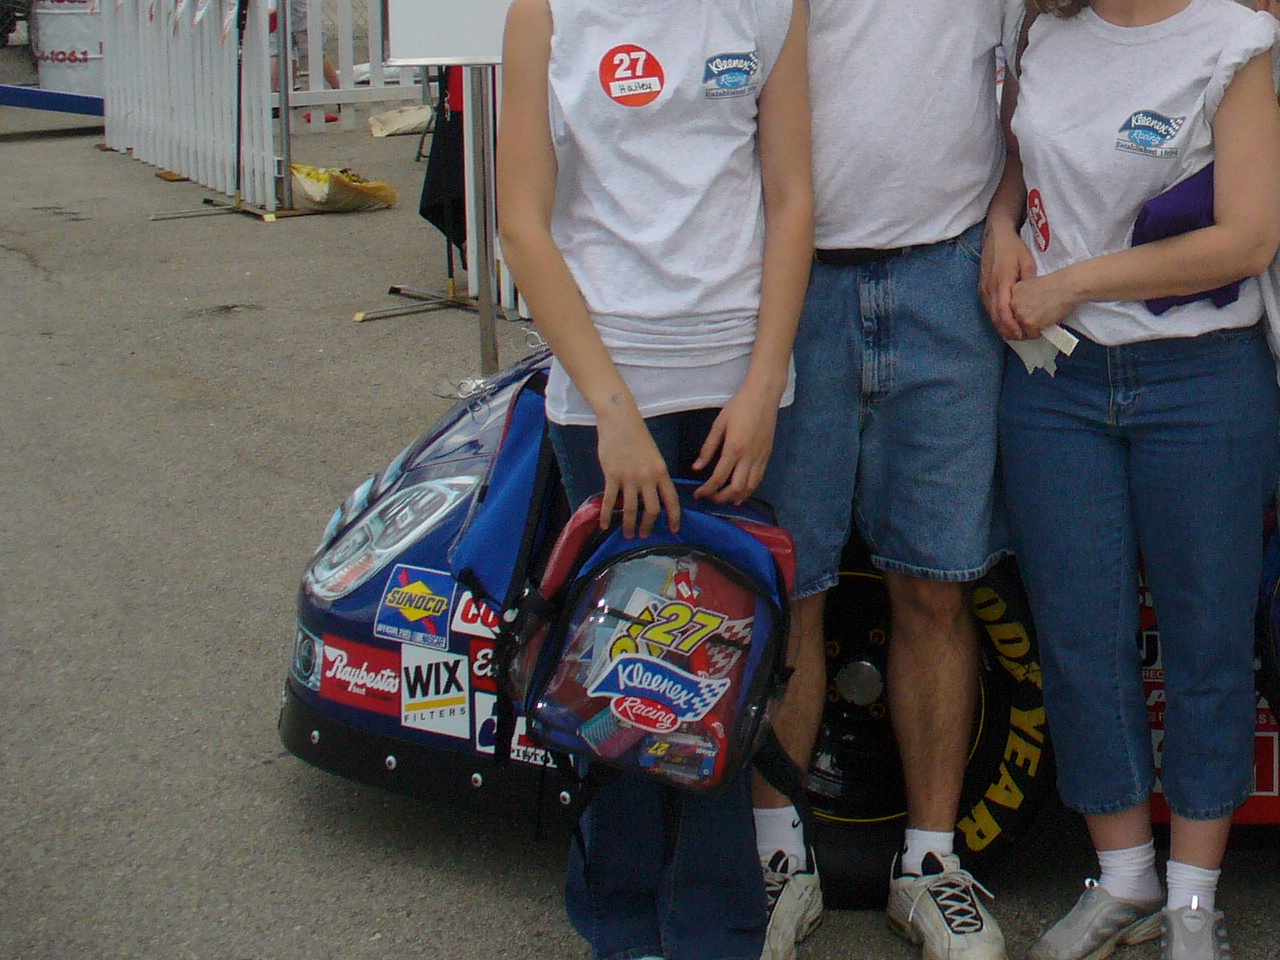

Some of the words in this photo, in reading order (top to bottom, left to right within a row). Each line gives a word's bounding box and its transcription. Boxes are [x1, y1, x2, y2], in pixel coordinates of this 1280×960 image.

[612, 51, 647, 79] 27
[708, 58, 751, 75] Kleenex
[1131, 113, 1169, 135] Kleenex
[387, 590, 449, 614] SUNOCO
[641, 602, 727, 654] 27
[325, 646, 400, 693] Raybestos
[403, 658, 465, 700] WIX
[617, 662, 694, 709] Kleenex
[404, 706, 467, 724] FILTERS
[617, 696, 678, 728] Racing
